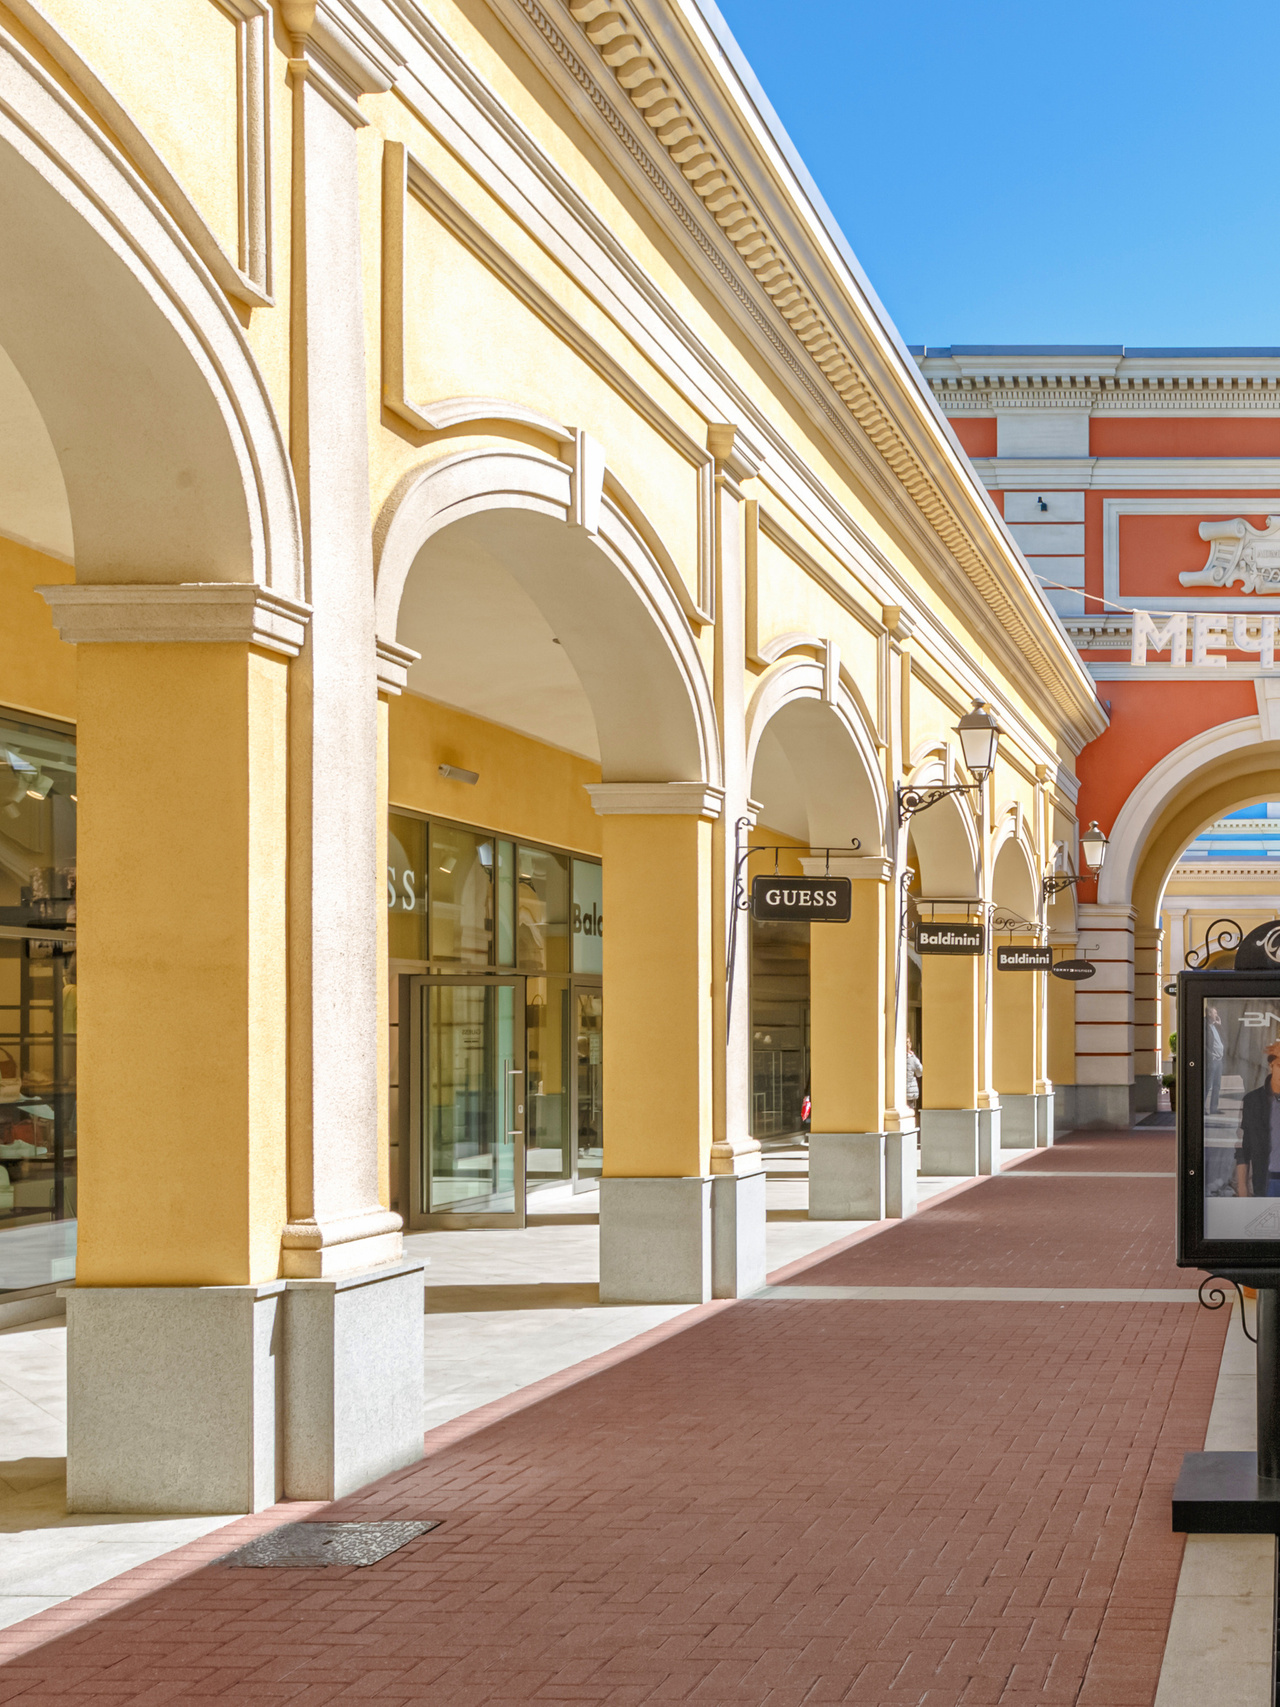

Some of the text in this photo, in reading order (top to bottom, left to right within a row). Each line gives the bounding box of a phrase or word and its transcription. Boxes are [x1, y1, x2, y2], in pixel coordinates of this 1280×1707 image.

[765, 889, 837, 907] GUESS
[920, 932, 980, 946] Baldinini
[1000, 953, 1050, 965] Baldinini
